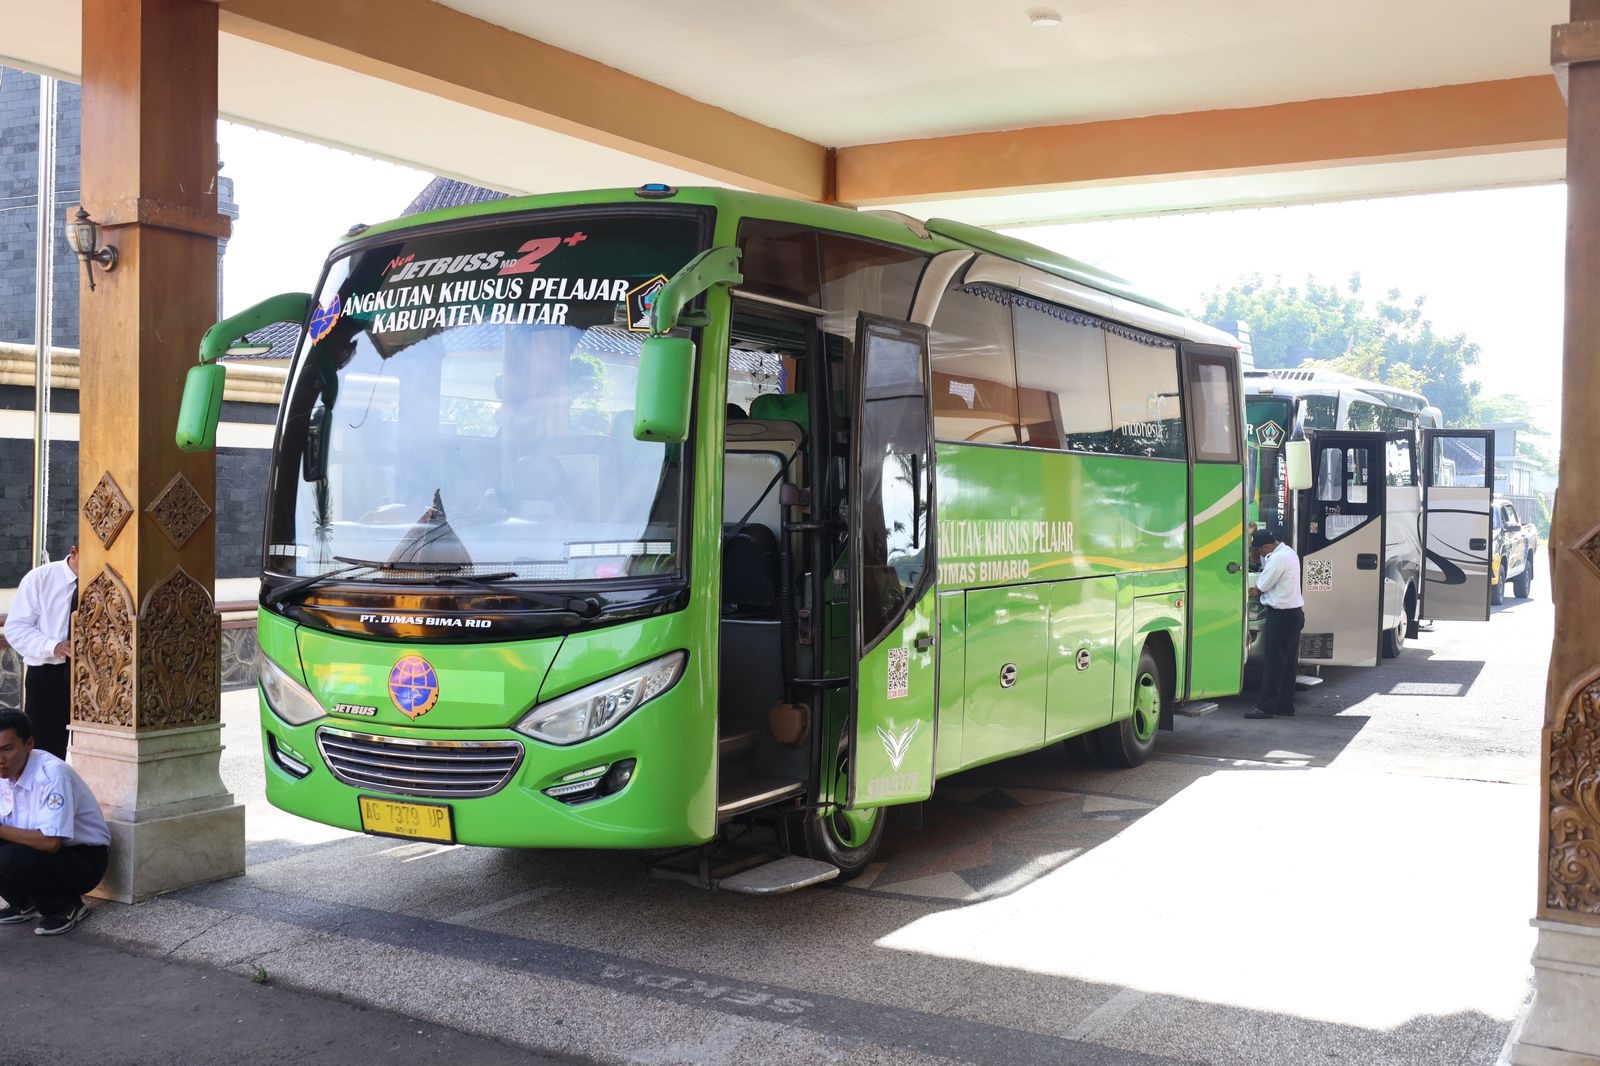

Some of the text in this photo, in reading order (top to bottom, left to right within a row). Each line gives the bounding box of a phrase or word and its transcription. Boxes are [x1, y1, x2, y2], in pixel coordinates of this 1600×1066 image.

[381, 253, 415, 276] New
[389, 251, 505, 283] JETBUSS
[500, 258, 518, 269] MD
[340, 277, 630, 317] ANGKUTAN KHUSUS PELAJAR
[372, 302, 568, 333] KABUPATEN BLITAR
[985, 520, 1030, 556] KHUSUS
[1032, 521, 1074, 553] PELAJAR
[980, 559, 1030, 582] BIMARIO
[360, 614, 492, 628] PT. DIMAS BIMA RIO
[331, 703, 377, 716] JETBUS
[366, 802, 444, 829] AG 7379 UP
